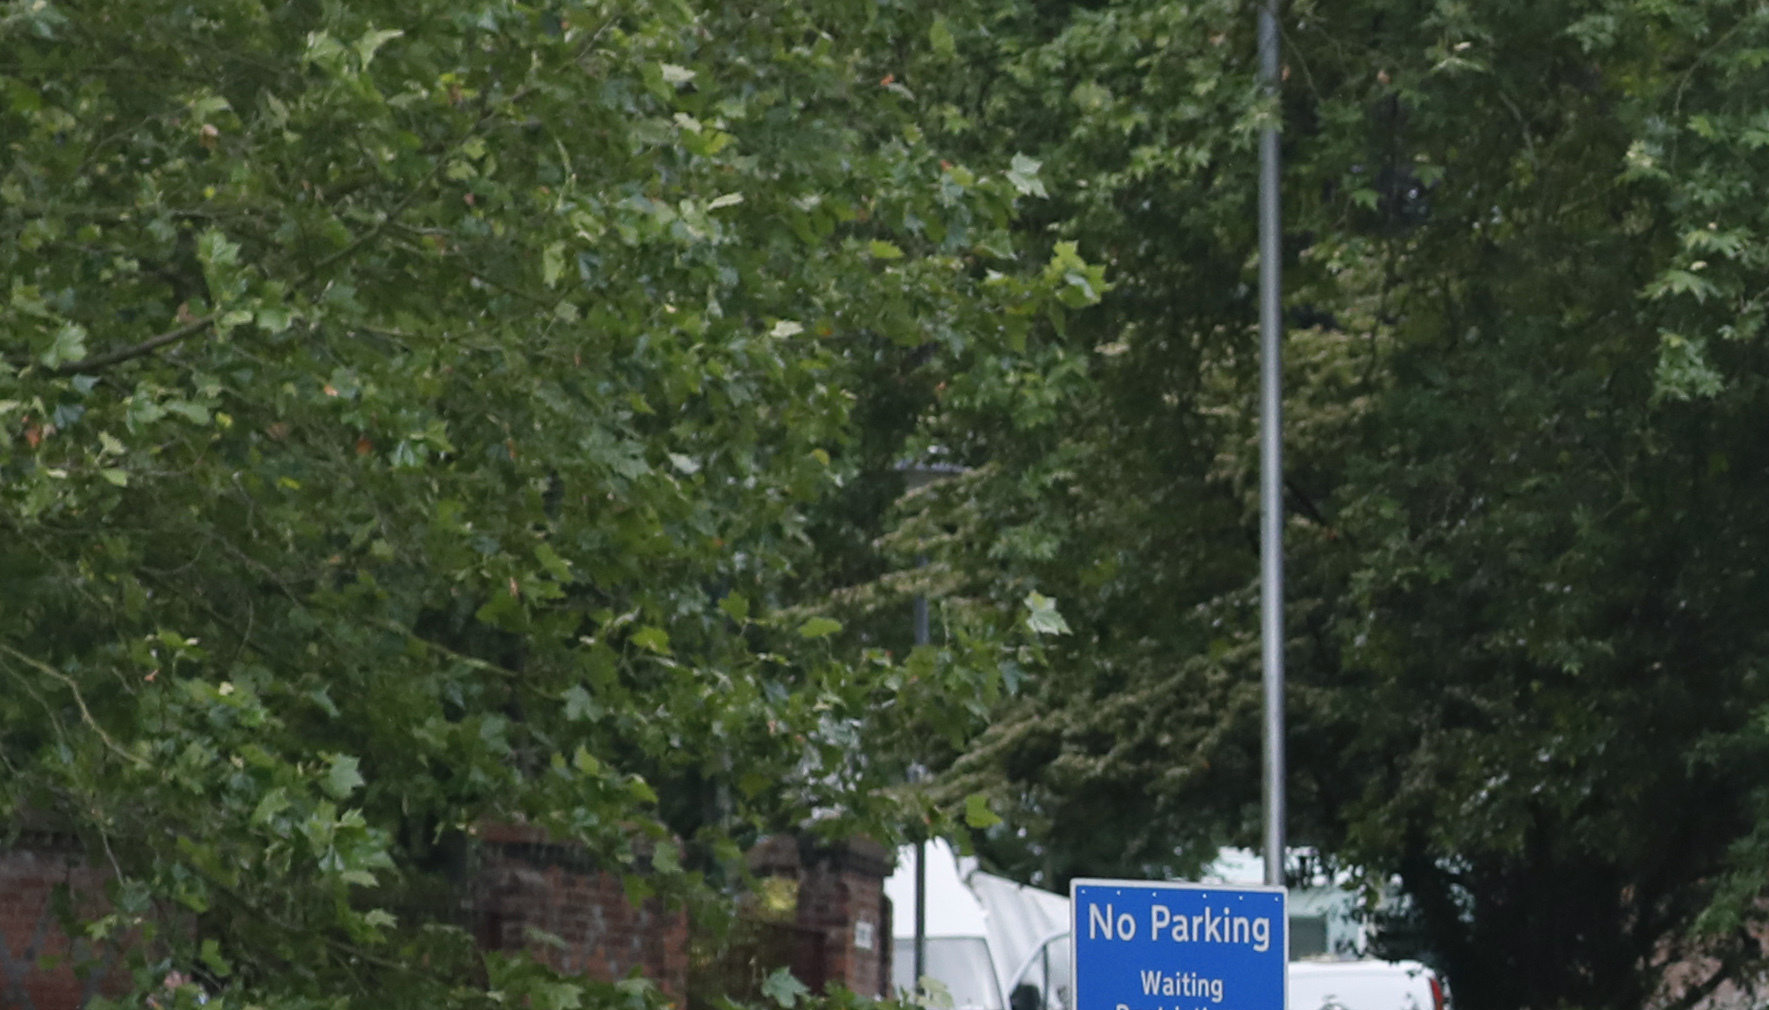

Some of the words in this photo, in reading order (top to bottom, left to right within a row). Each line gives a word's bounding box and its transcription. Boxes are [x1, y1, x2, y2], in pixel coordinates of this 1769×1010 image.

[1088, 902, 1137, 941] No
[1151, 904, 1271, 952] Parking
[1140, 969, 1224, 1003] Waiting
